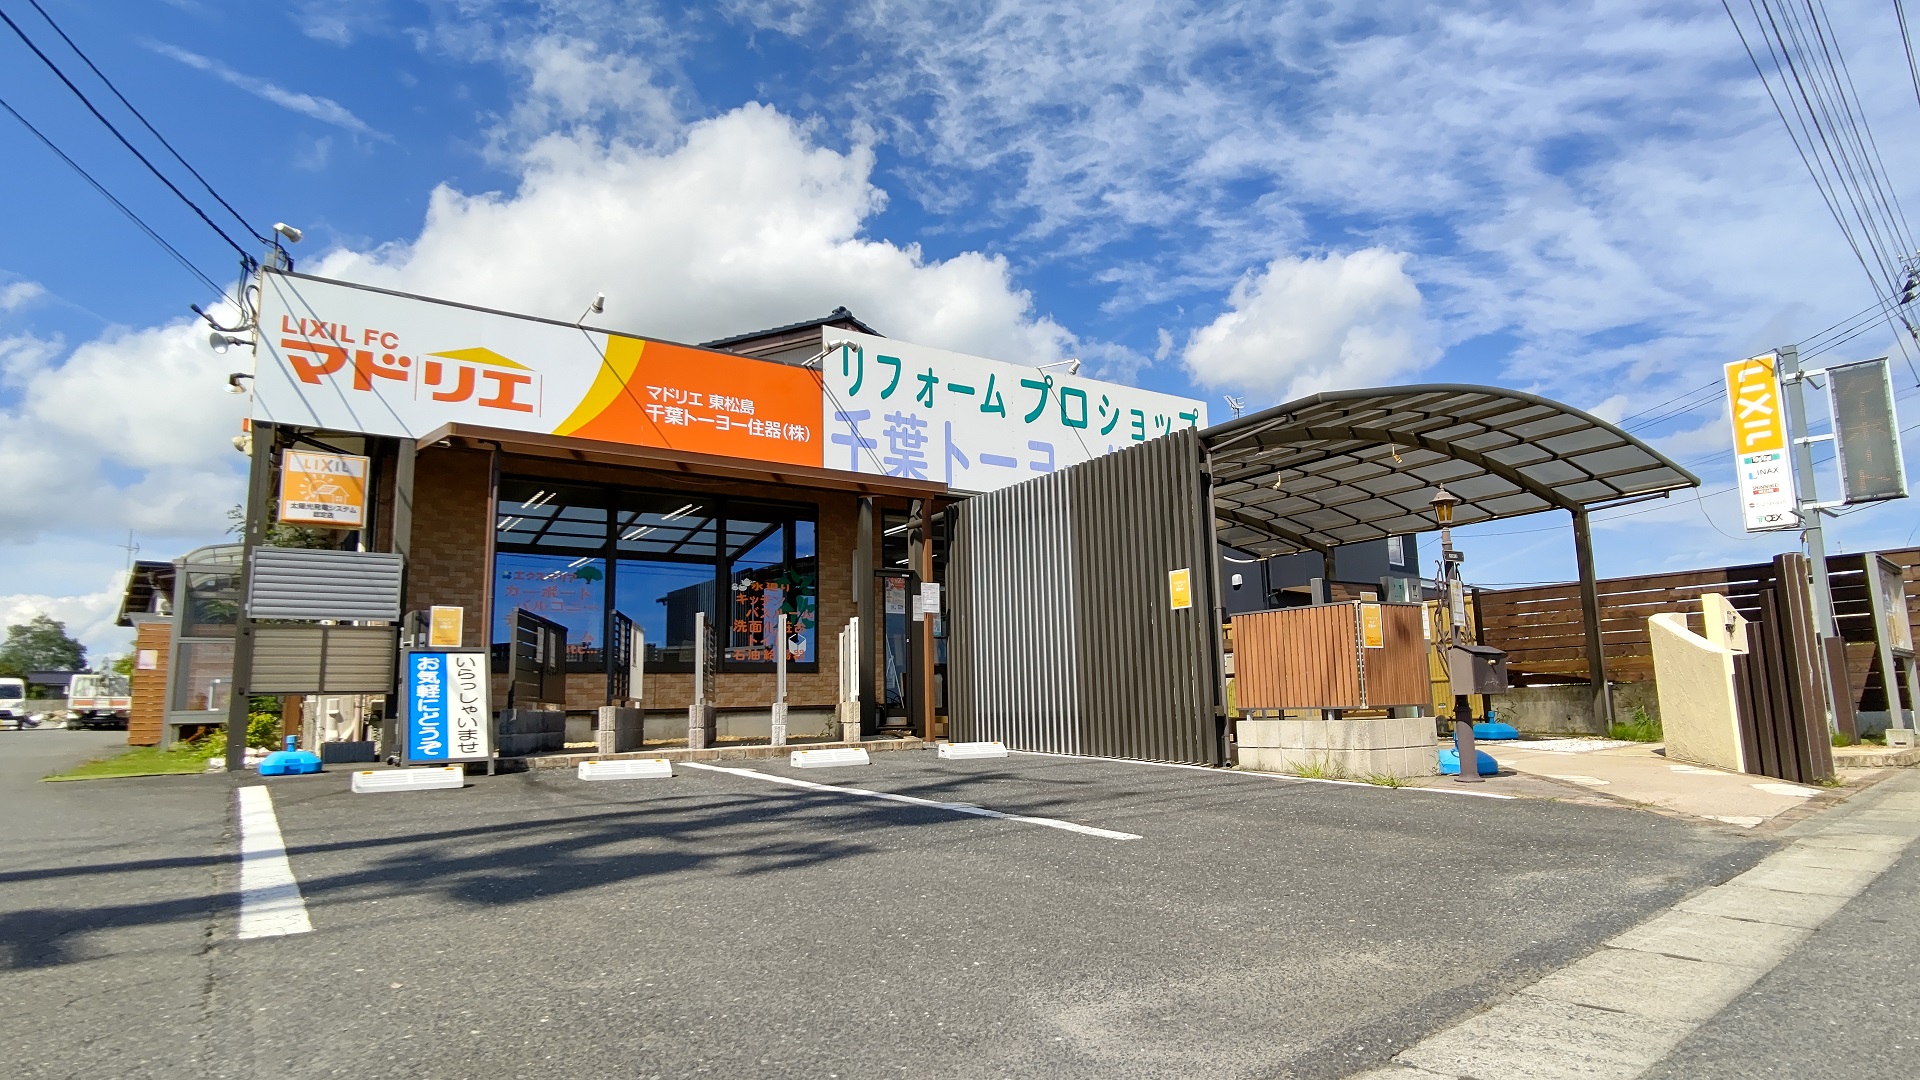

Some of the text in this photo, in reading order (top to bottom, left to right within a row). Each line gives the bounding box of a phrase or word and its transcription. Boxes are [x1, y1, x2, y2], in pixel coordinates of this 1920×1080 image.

[282, 314, 400, 350] LIXIL FC
[281, 337, 535, 414] マドリエ
[646, 384, 756, 416] マドリエ 東松島
[1737, 366, 1774, 447] LIXIL
[303, 458, 350, 473] LIXIL
[831, 409, 1120, 488] 千葉トーヨ
[505, 585, 591, 600] カーポート
[735, 592, 786, 605] キッチン
[456, 657, 480, 754] いらっしゃいませ
